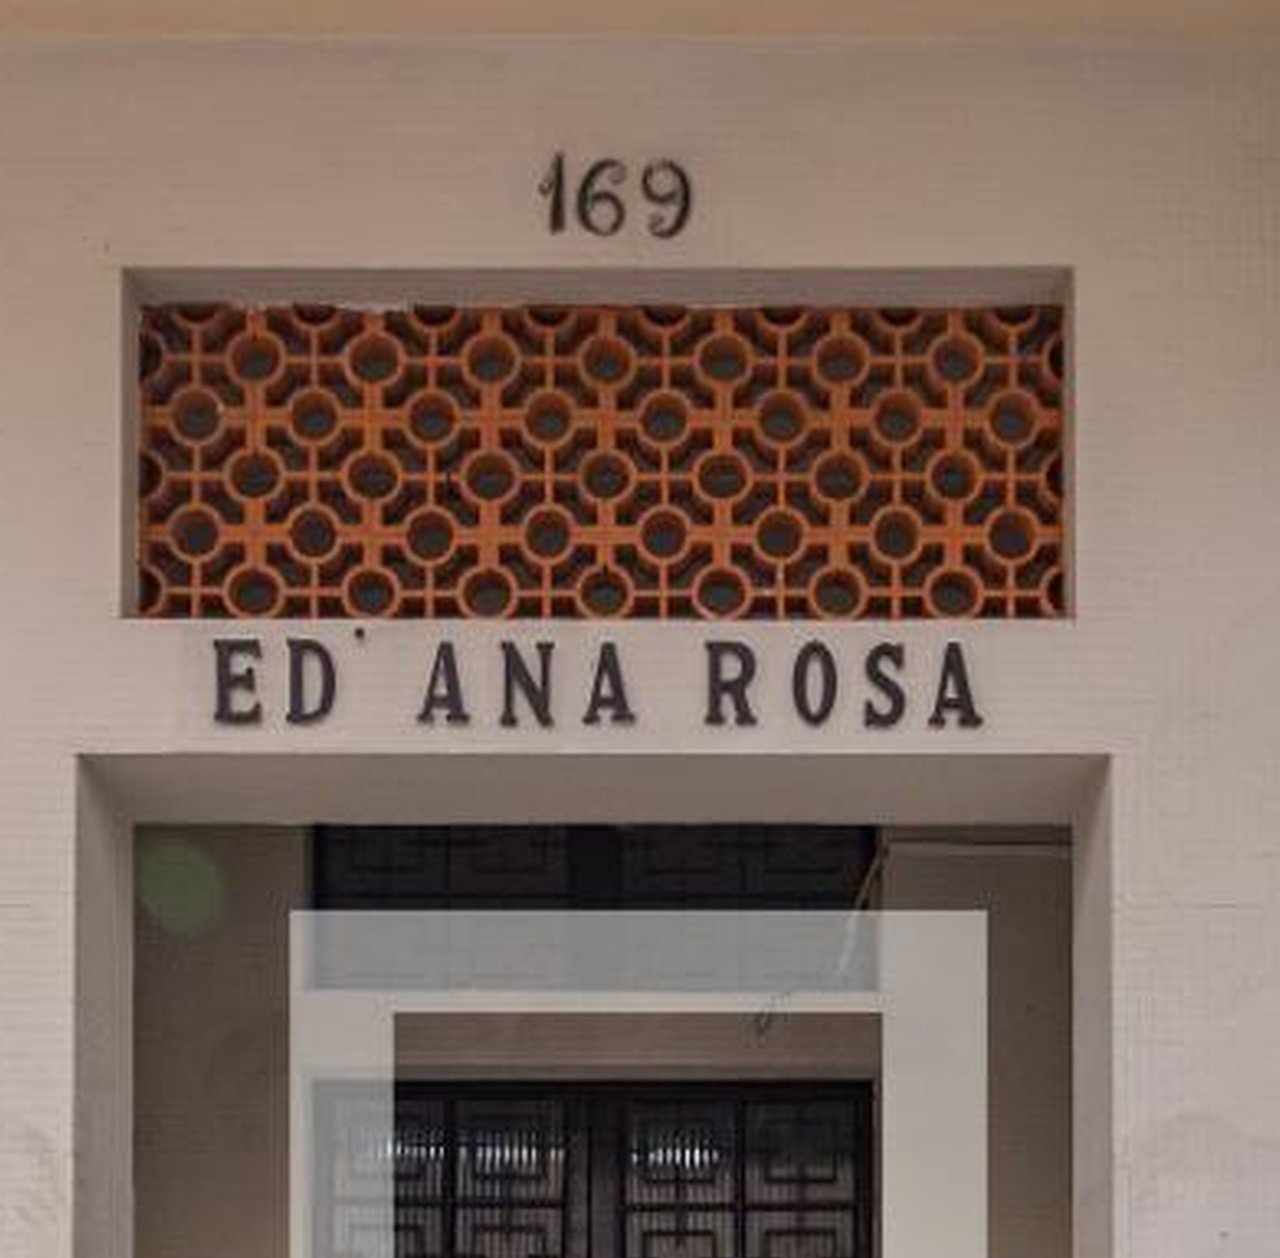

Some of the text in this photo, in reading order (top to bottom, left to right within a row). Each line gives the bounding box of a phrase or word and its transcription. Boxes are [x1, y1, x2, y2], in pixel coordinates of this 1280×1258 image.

[538, 152, 692, 239] 169
[417, 640, 636, 727] ANA
[704, 640, 983, 727] ROSA
